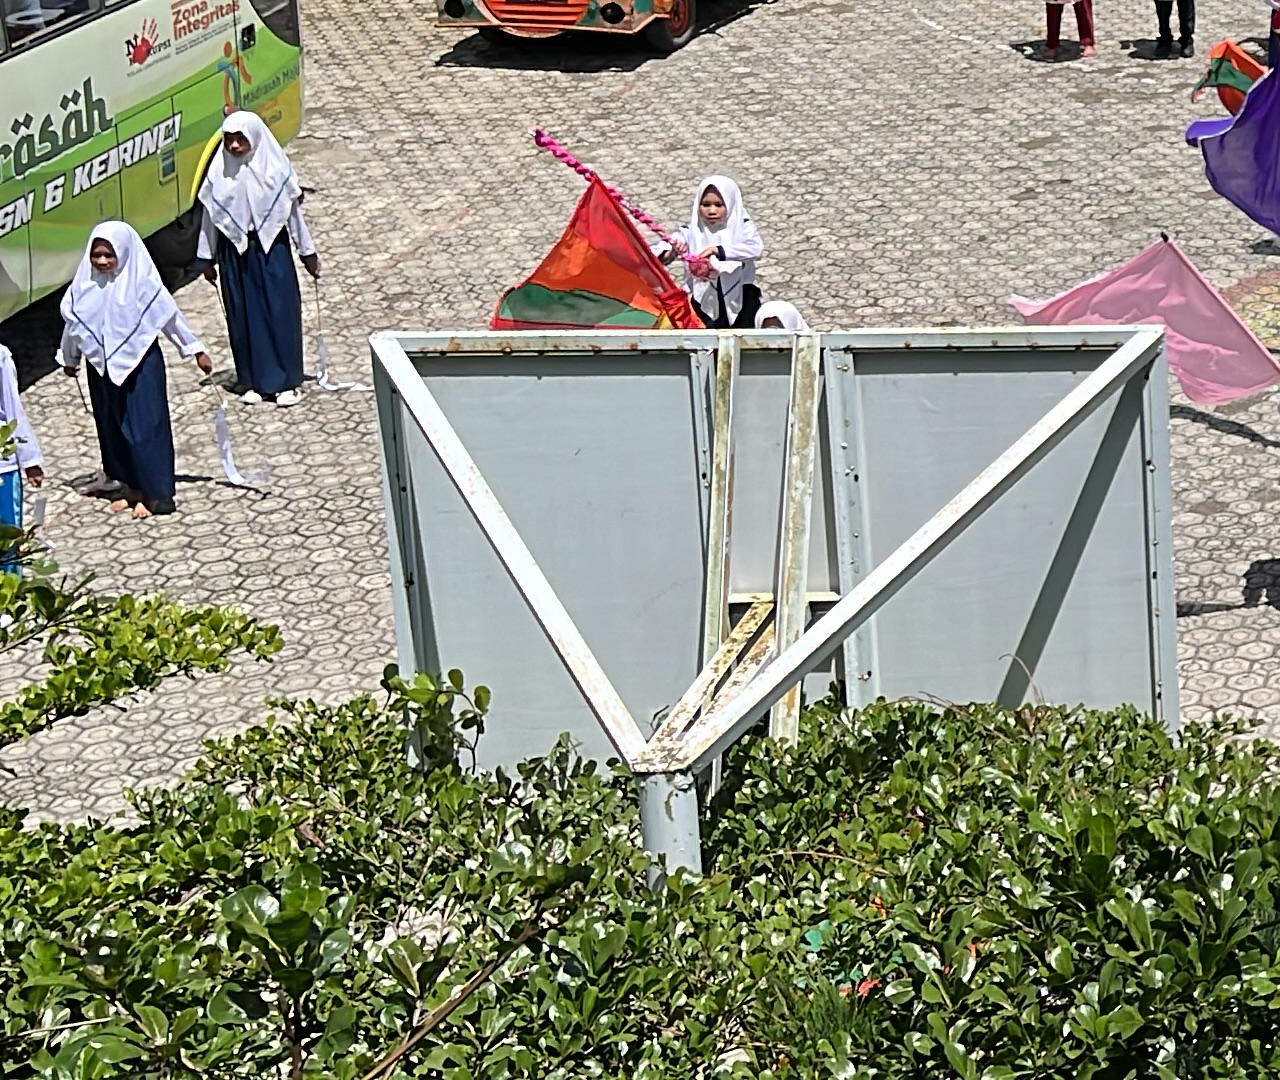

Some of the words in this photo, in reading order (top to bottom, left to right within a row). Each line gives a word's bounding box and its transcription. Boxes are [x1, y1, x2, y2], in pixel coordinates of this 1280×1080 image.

[172, 1, 209, 25] Zona
[173, 0, 241, 40] Integritas
[44, 174, 66, 214] 6
[73, 111, 182, 197] KERINCI
